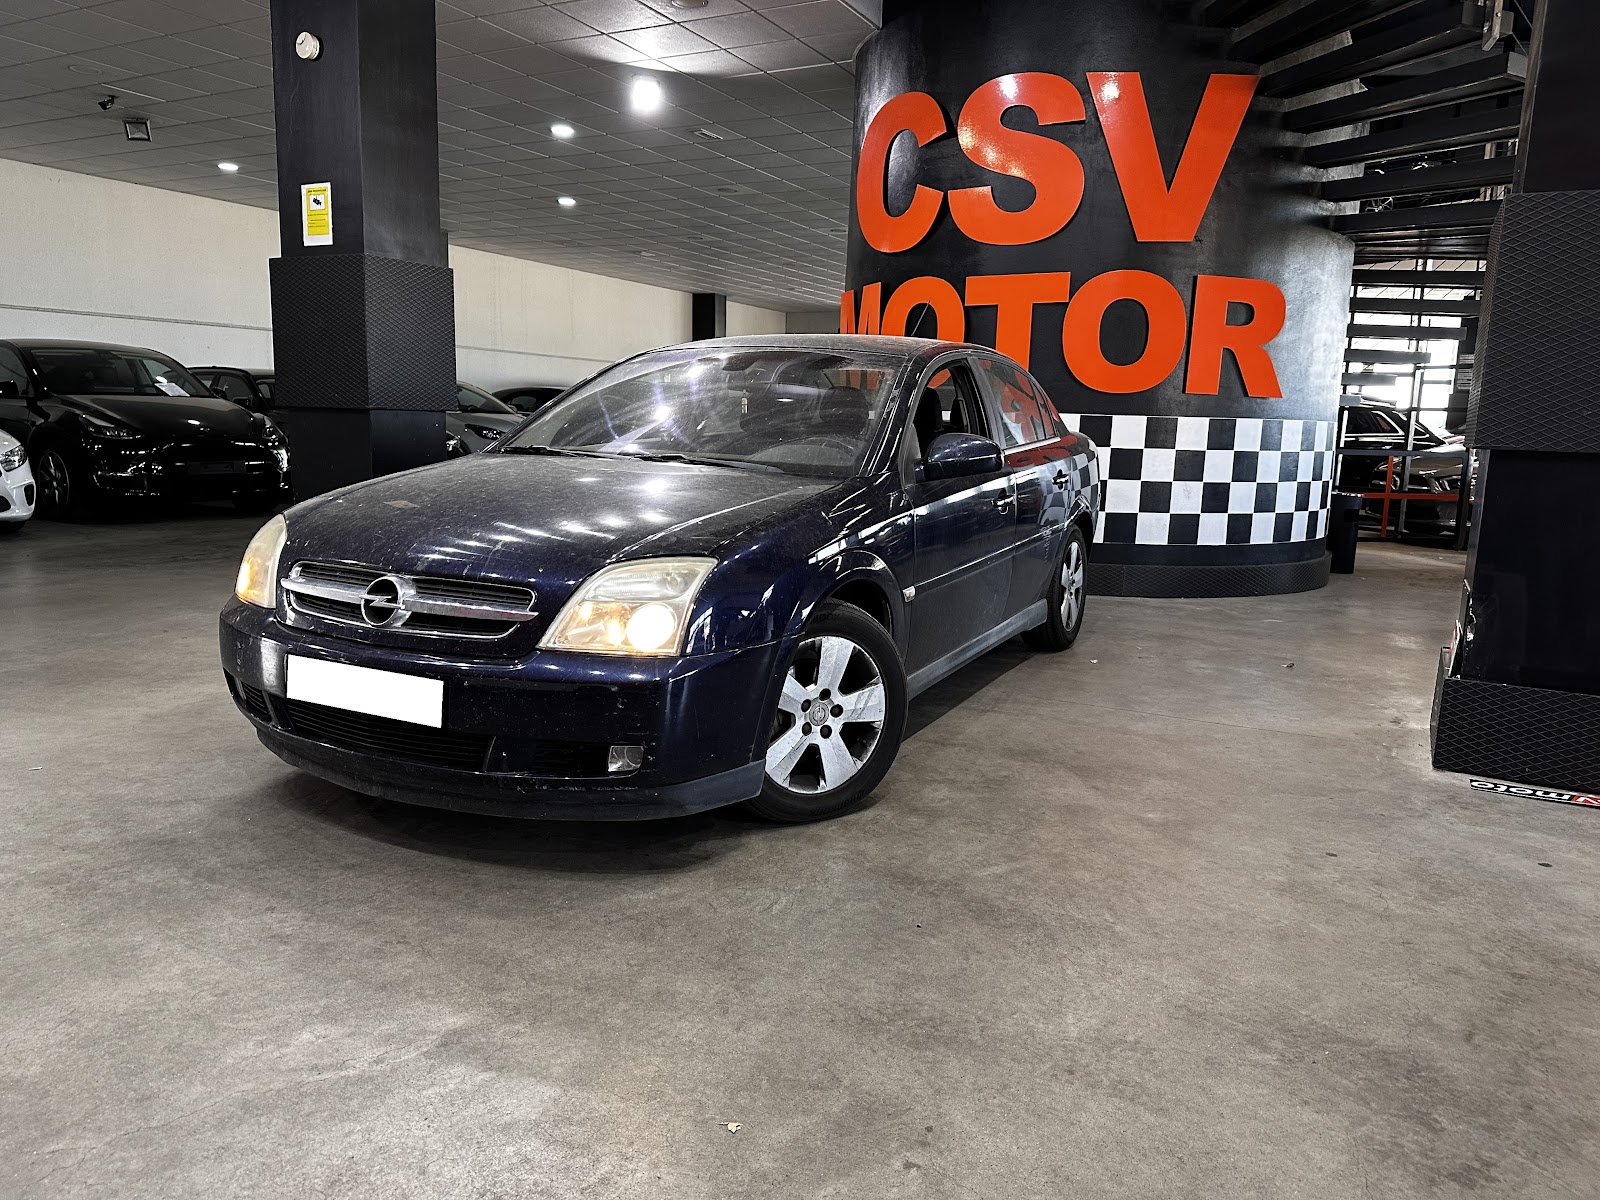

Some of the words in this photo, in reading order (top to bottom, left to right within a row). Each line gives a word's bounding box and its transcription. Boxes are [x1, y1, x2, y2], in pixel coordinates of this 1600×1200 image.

[856, 71, 1260, 253] CSV
[840, 269, 1287, 398] MOTOR
[1471, 781, 1571, 800] moto
